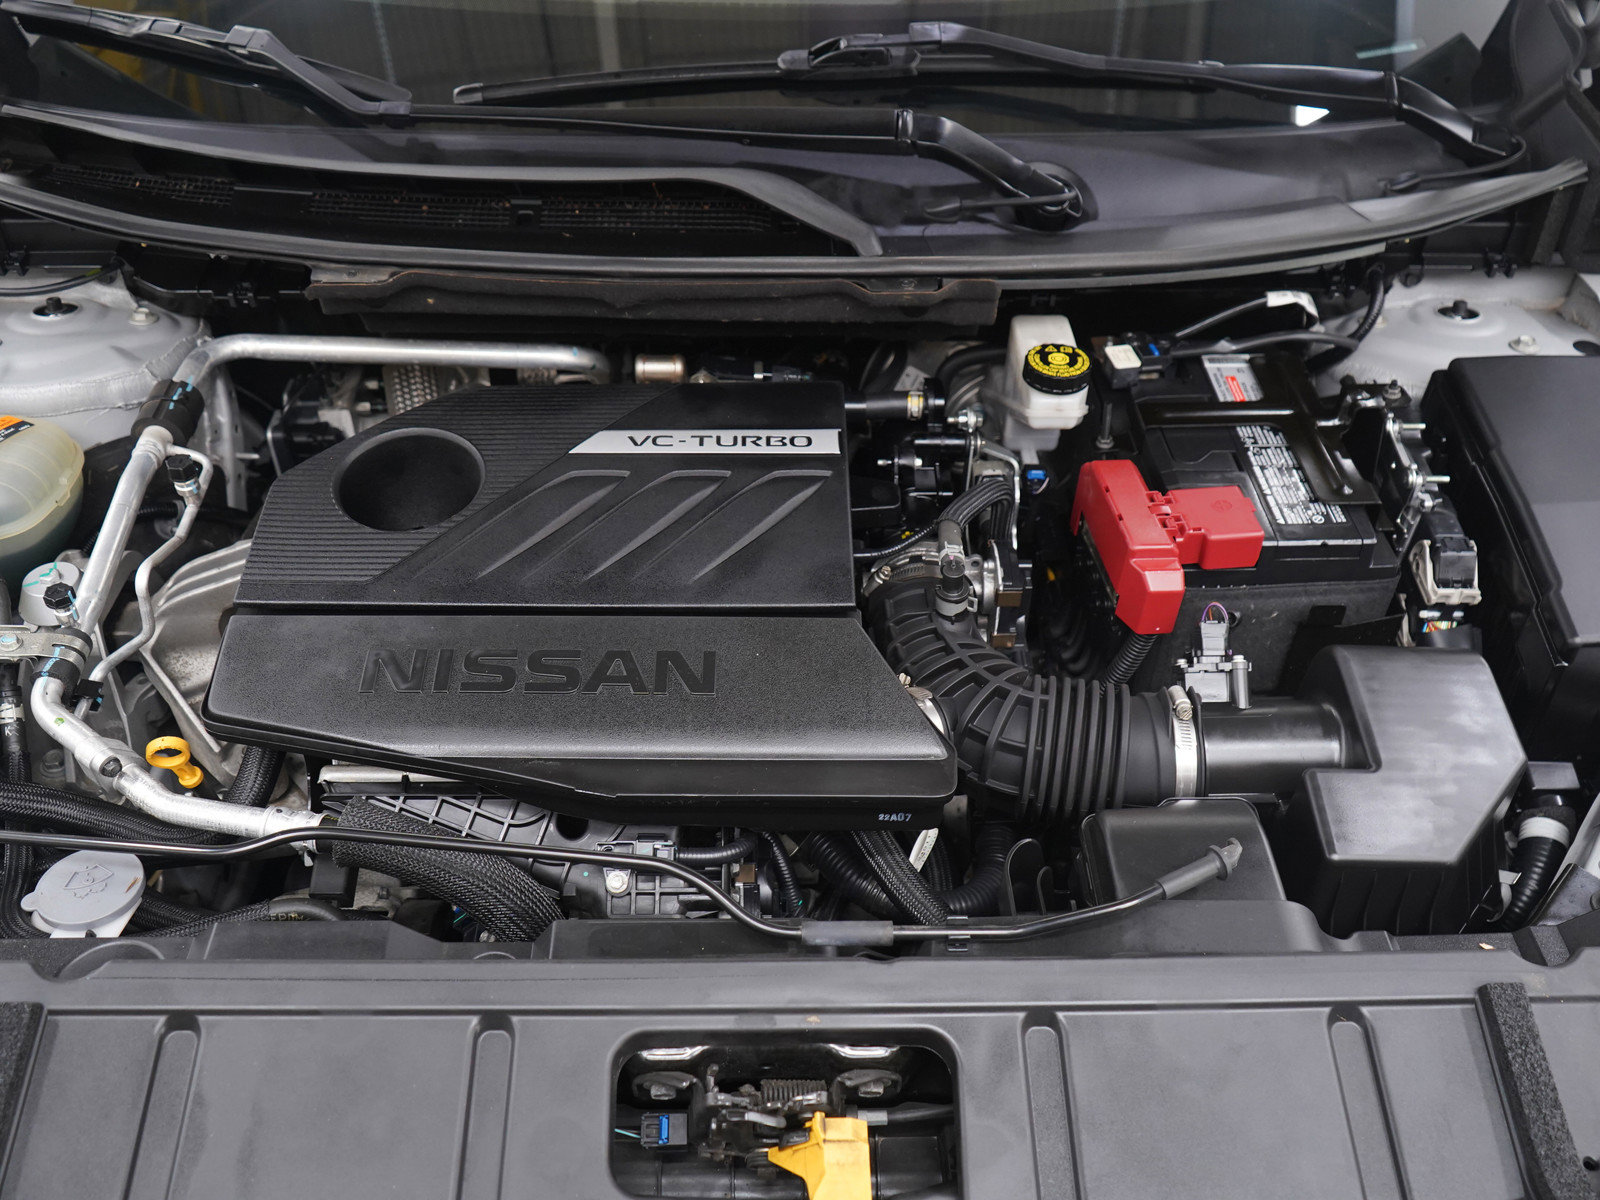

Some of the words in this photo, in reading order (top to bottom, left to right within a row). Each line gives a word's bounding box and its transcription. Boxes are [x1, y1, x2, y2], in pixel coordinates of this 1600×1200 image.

[627, 435, 813, 447] VC-TURBO
[358, 649, 716, 696] NISSAN
[878, 812, 912, 822] 22A07
